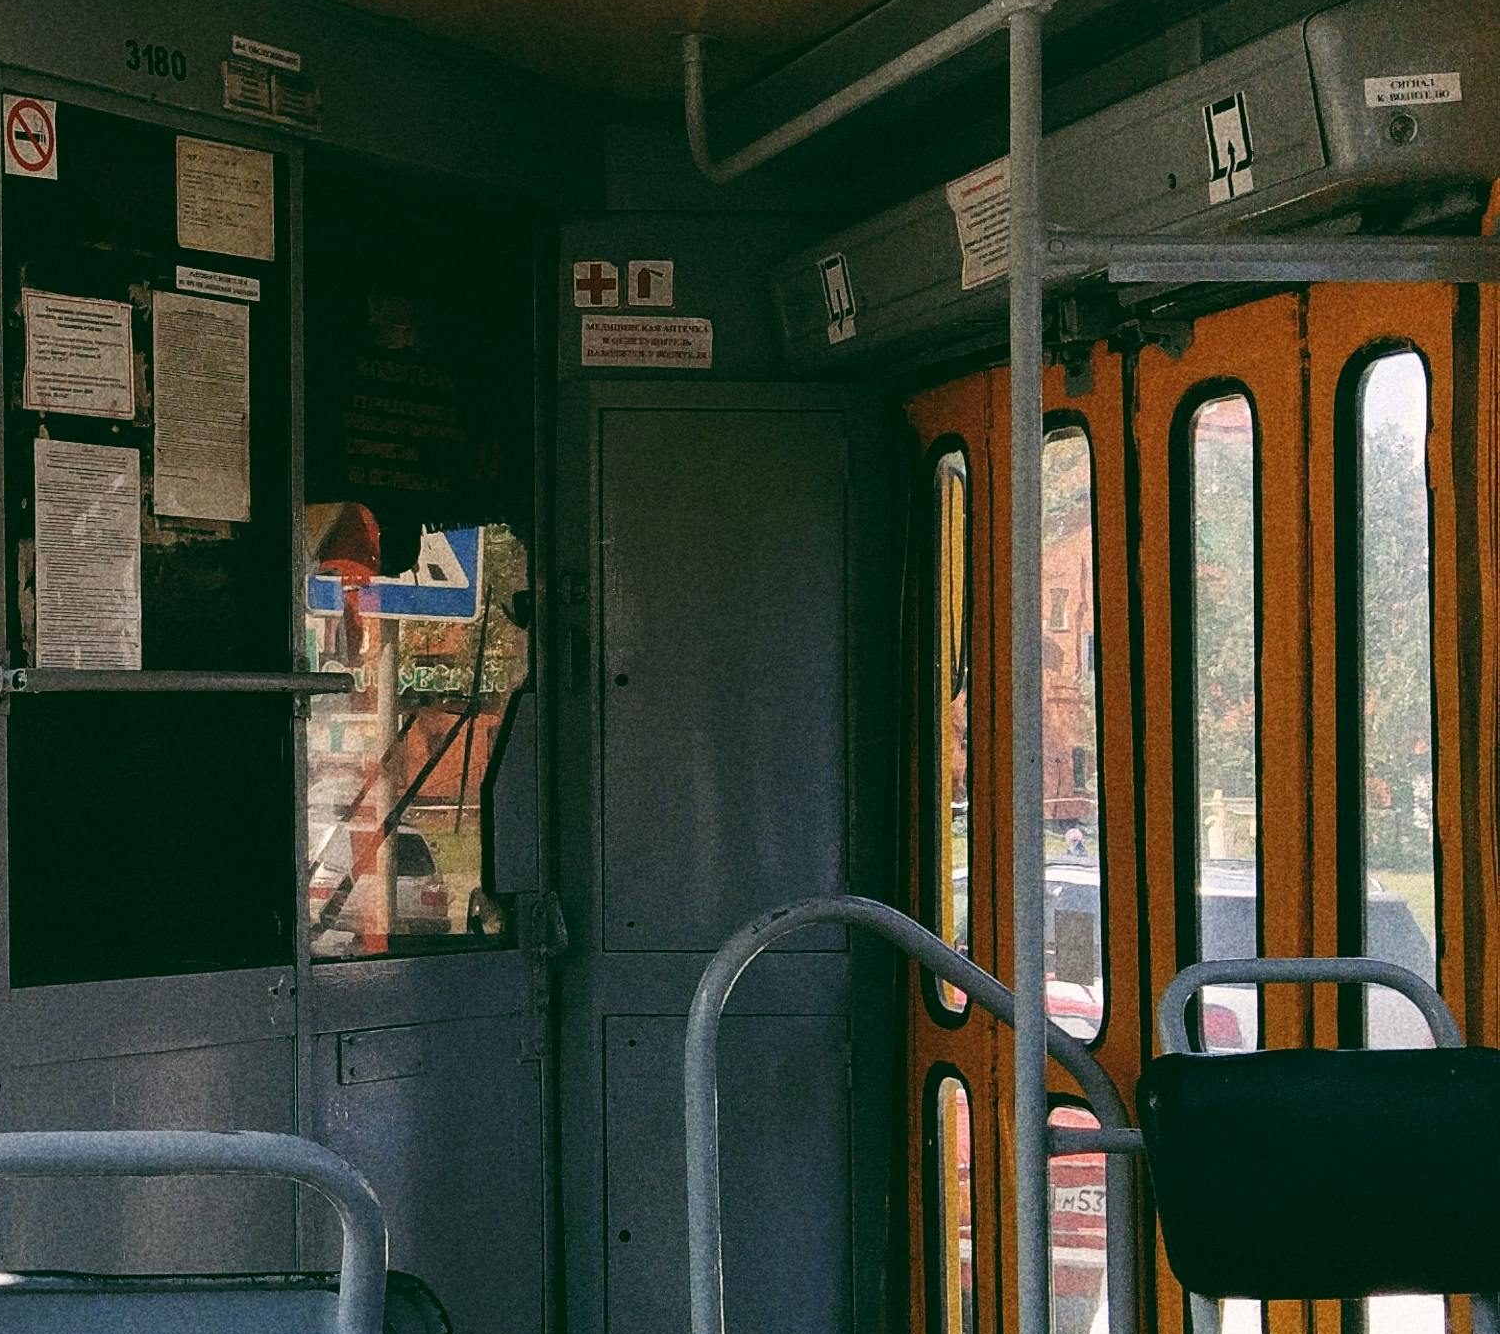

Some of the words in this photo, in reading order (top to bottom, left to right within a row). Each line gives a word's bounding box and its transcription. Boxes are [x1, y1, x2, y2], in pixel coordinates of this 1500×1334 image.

[124, 38, 188, 82] 3180
[1390, 78, 1435, 89] СИГНАЛ
[1377, 94, 1385, 102] К
[1389, 90, 1450, 101] ВОДИТЕЛЮ
[663, 324, 708, 334] АПТЕЧКА
